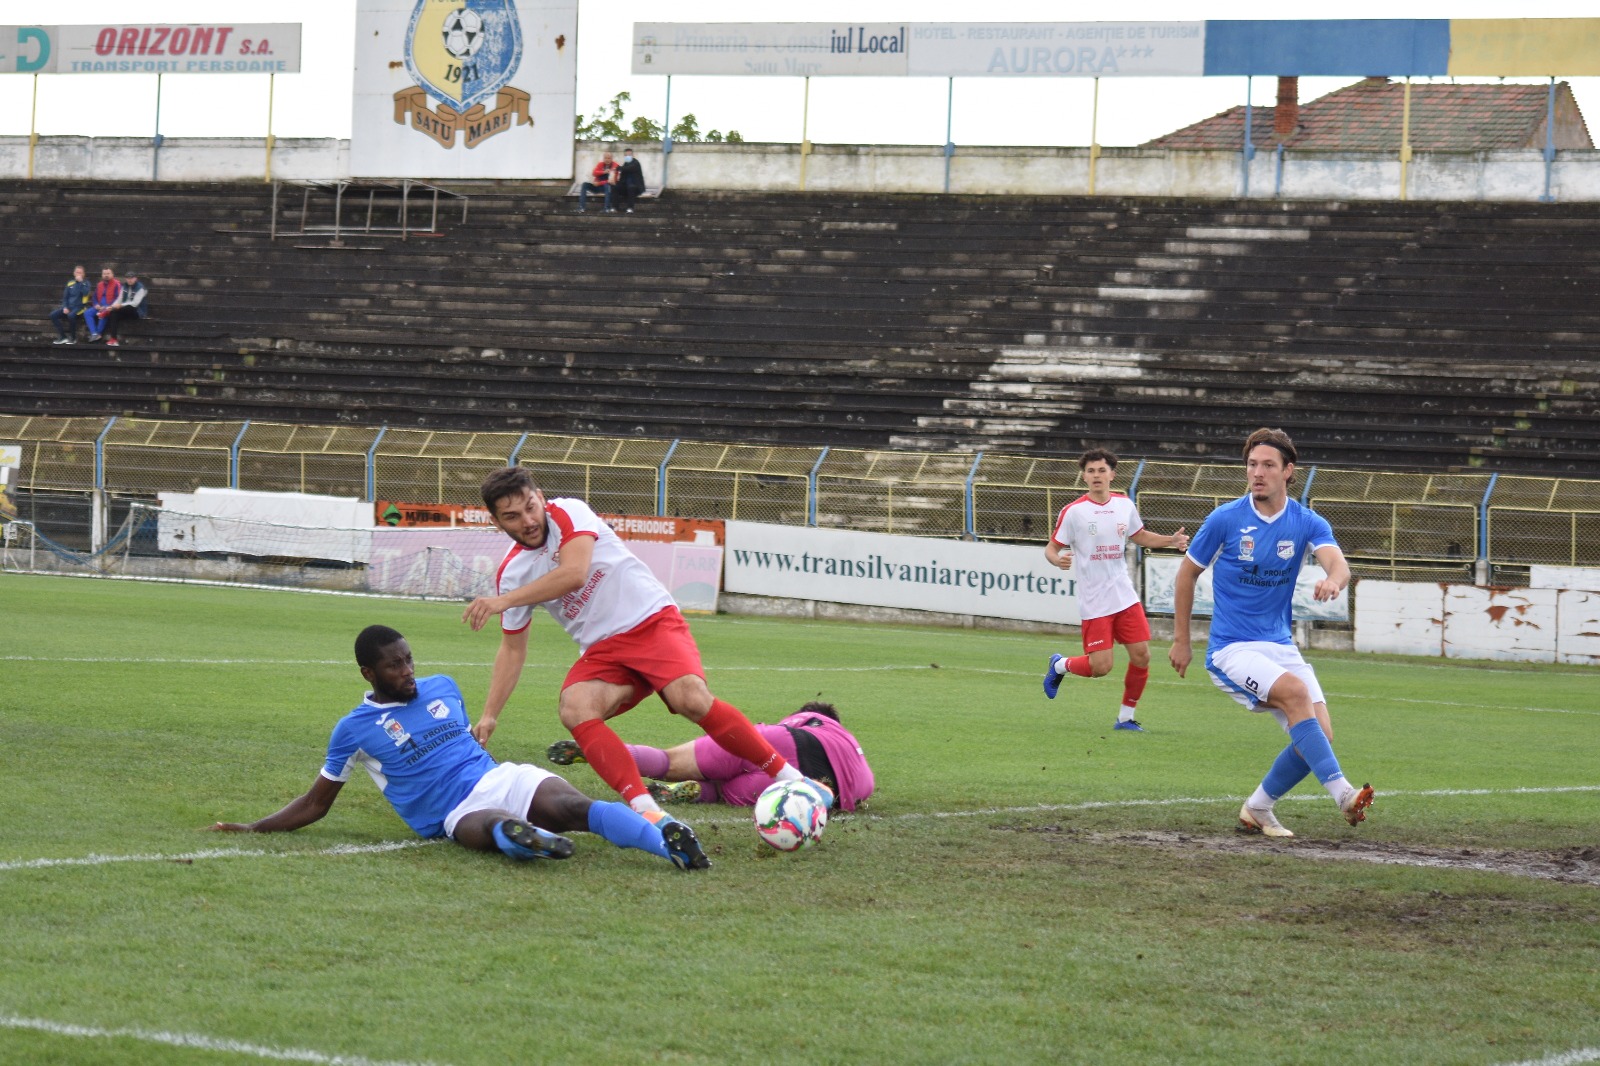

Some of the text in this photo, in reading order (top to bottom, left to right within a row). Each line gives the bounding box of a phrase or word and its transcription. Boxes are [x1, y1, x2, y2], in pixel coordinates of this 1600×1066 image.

[95, 26, 274, 56] ORIZONT S.A.
[857, 26, 904, 53] Local
[914, 27, 957, 40] HOTEL
[968, 27, 1054, 40] RESTAURANT
[1127, 27, 1145, 39] DE
[1149, 25, 1200, 39] TURISM
[71, 60, 286, 72] TRANSPORT PERSOANE
[443, 64, 480, 83] 1921
[416, 112, 508, 141] SATU MARE
[625, 519, 676, 535] PERIODICE
[677, 556, 717, 571] TARR
[1244, 675, 1259, 695] 15
[422, 720, 459, 742] PROIECT
[407, 729, 463, 766] TRANSILVANIA
